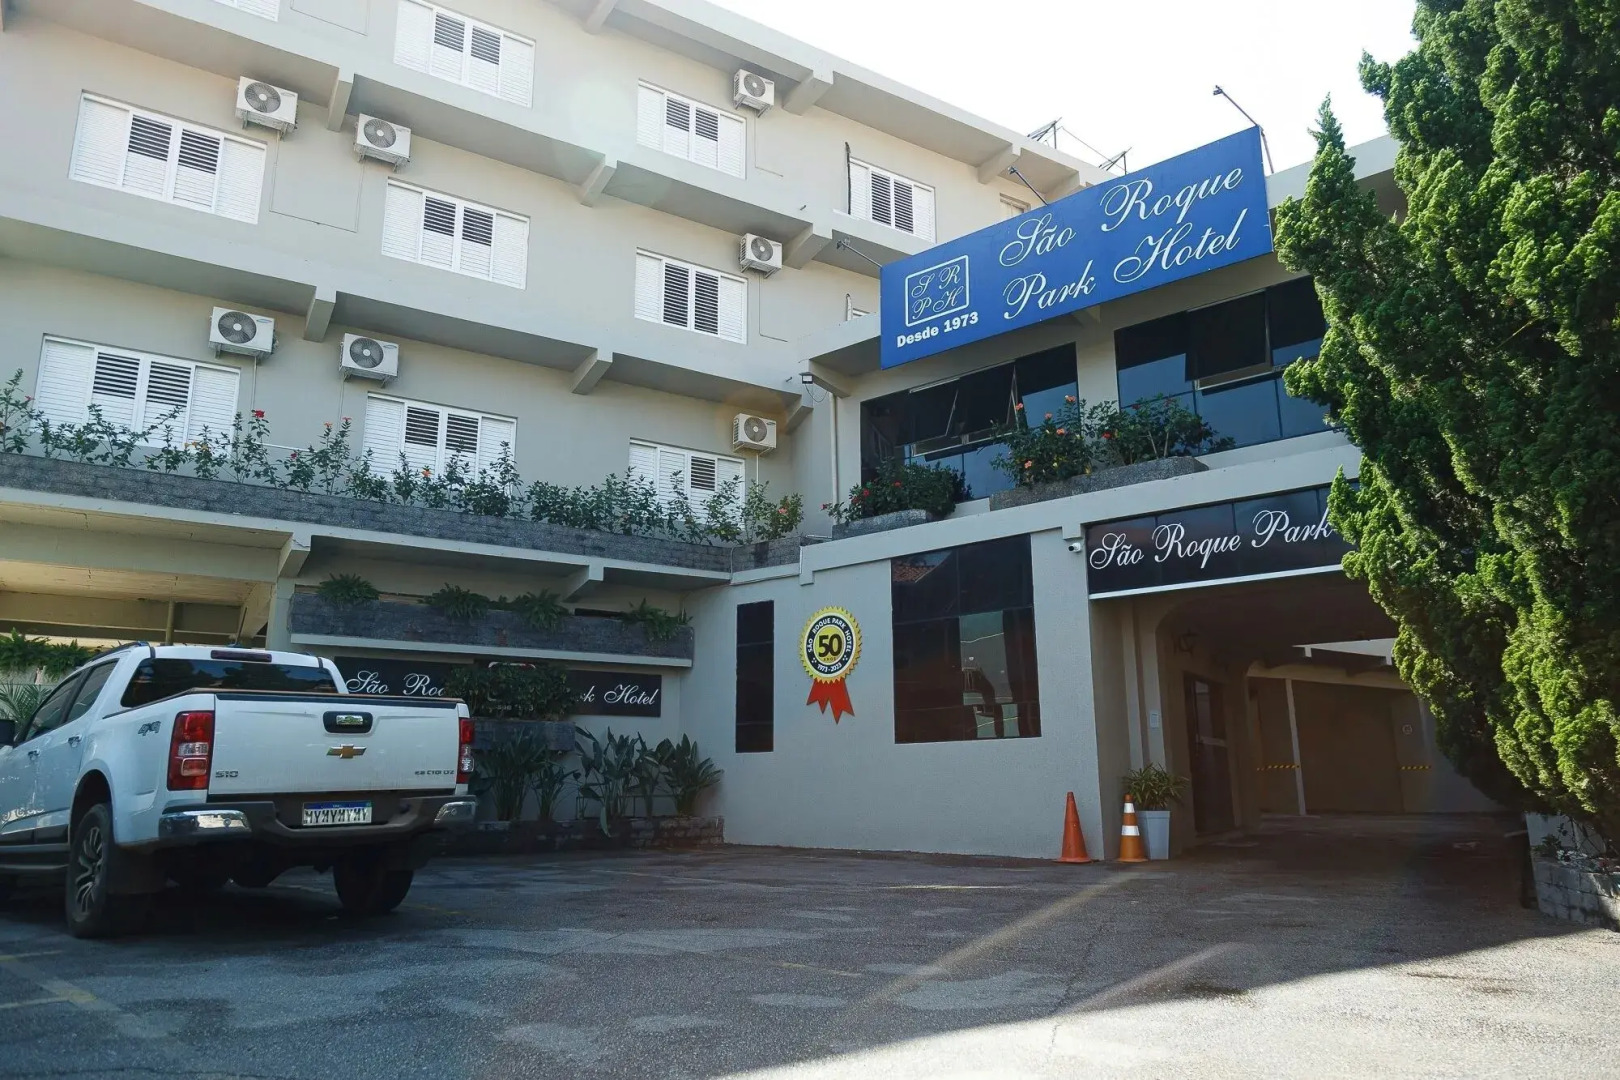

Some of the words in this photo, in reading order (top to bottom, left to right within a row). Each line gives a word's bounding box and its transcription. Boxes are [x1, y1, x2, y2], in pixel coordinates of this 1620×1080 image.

[999, 212, 1077, 267] São
[1099, 167, 1244, 233] Roque
[1002, 259, 1097, 321] Park
[1113, 208, 1249, 284] Hotel
[896, 326, 940, 348] Desde
[943, 311, 979, 333] 1973
[1089, 532, 1145, 570] São
[1151, 521, 1242, 569] Roque
[1250, 507, 1338, 548] Park
[832, 618, 846, 629] PARK
[818, 633, 843, 658] 50
[346, 670, 389, 694] São
[603, 684, 659, 705] Hotel
